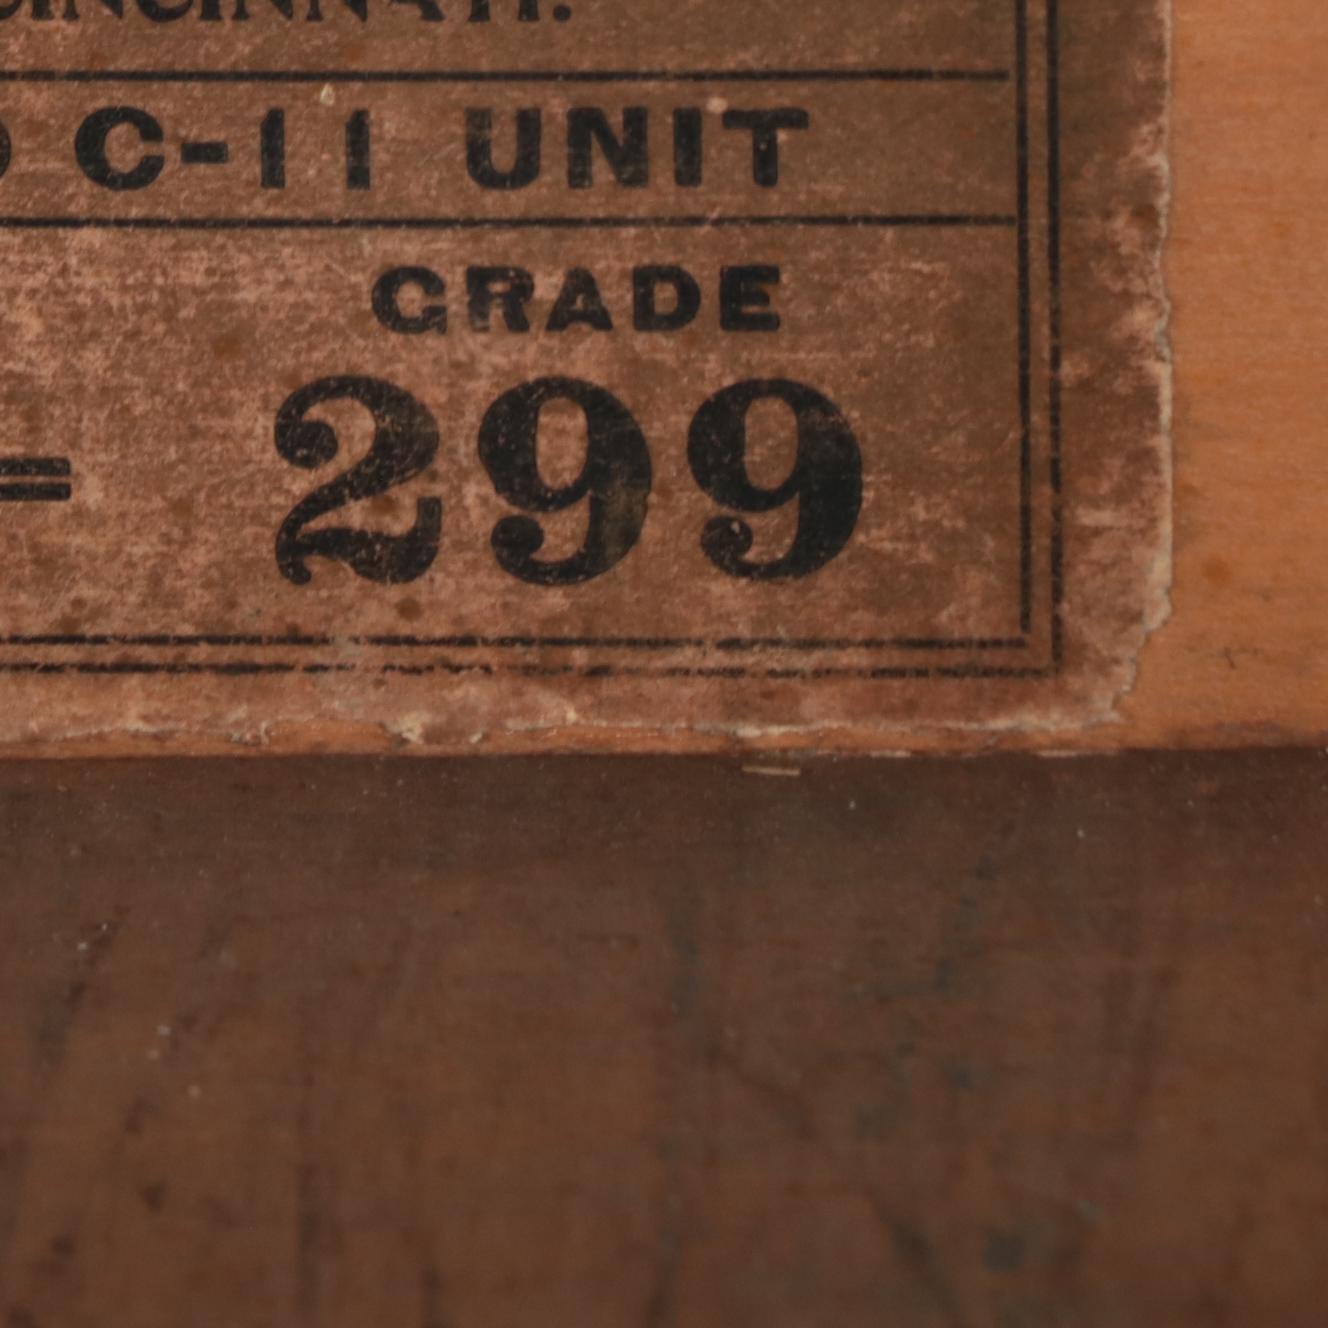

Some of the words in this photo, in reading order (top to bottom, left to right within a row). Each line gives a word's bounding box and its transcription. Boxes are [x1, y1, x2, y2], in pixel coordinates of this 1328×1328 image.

[73, 105, 372, 191] C-11
[464, 106, 810, 190] UNIT
[370, 264, 782, 335] GRADE
[272, 374, 864, 586] 299
